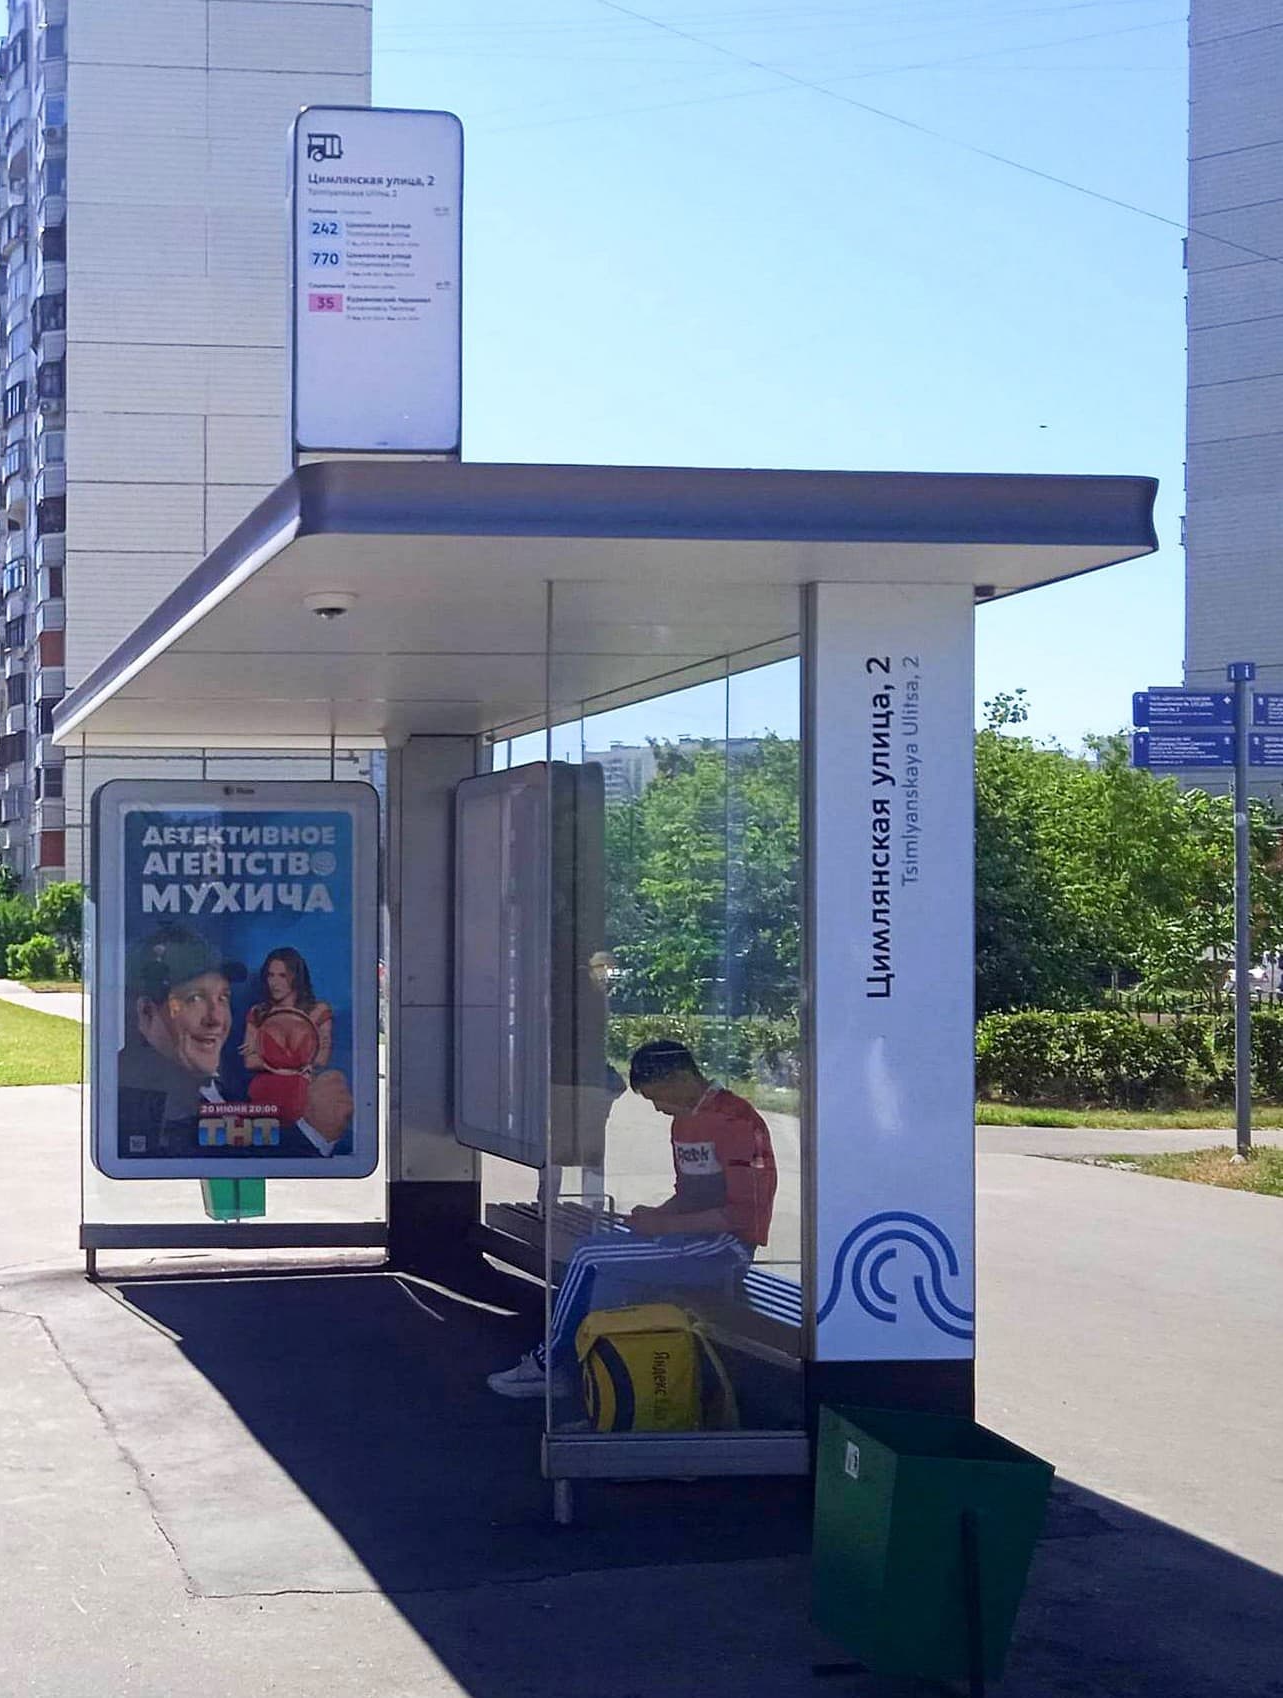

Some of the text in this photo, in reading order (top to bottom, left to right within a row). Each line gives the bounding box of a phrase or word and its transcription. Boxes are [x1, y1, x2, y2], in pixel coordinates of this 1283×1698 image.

[308, 173, 383, 184] Цимлянская
[427, 175, 435, 186] 2
[312, 222, 338, 235] 242
[312, 252, 339, 265] 770
[317, 296, 335, 310] 35
[901, 656, 922, 886] Tsimlyanskaya Ulitsa, 2
[142, 826, 336, 847] ДЕТЕКТИВНОЕ
[866, 656, 896, 998] Цимлянская улица, 2
[142, 851, 337, 876] АГЕНТСТВО
[142, 882, 335, 914] МУХИЧА
[202, 1104, 215, 1113] 20
[198, 1115, 280, 1146] ТНТ
